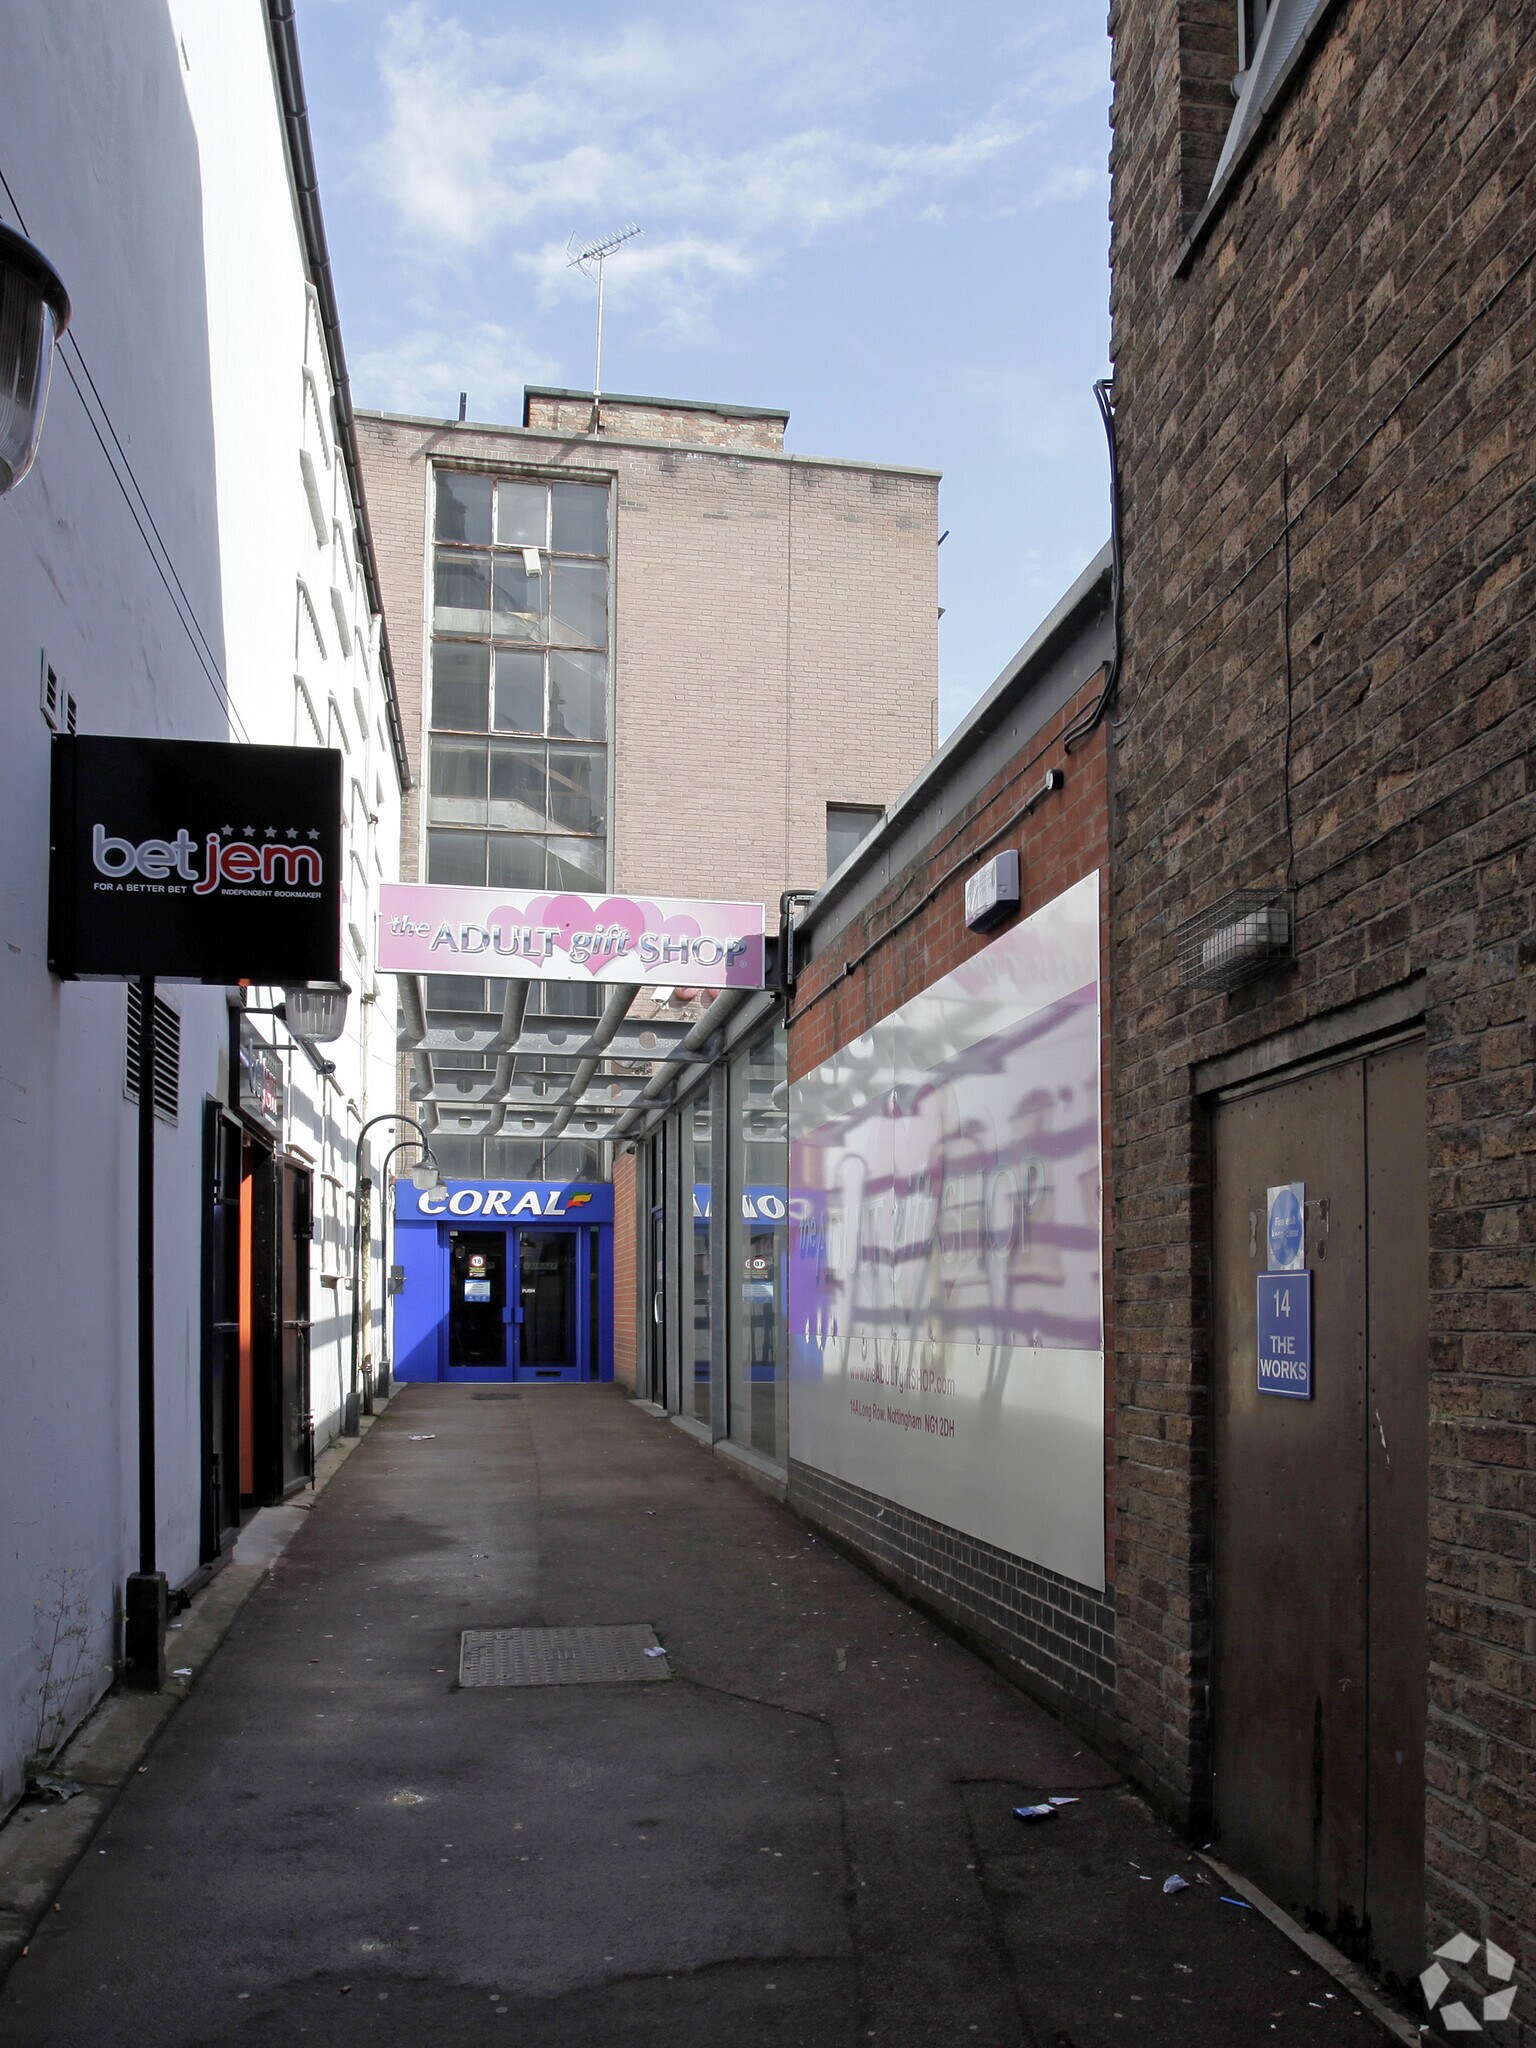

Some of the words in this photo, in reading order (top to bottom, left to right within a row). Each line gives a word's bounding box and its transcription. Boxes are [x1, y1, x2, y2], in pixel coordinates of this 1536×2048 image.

[93, 882, 113, 891] FOR
[116, 883, 124, 891] A
[126, 884, 165, 893] BETTER
[167, 885, 188, 894] BET
[221, 889, 272, 897] INDEPENDENT
[389, 914, 431, 937] the
[430, 923, 559, 957] ADULT
[569, 924, 630, 964] gift
[639, 932, 747, 967] SHOP
[418, 1190, 567, 1215] CORAL
[939, 1157, 1046, 1263] SHOP
[1275, 1217, 1284, 1226] Fire
[1272, 1230, 1284, 1240] keep
[1273, 1289, 1291, 1318] 14
[1270, 1335, 1295, 1355] THE
[1260, 1358, 1307, 1381] WORKS
[859, 1401, 872, 1422] Long
[887, 1406, 922, 1431] Nottingham
[924, 1414, 938, 1435] NG1
[939, 1417, 955, 1438] 2DH
